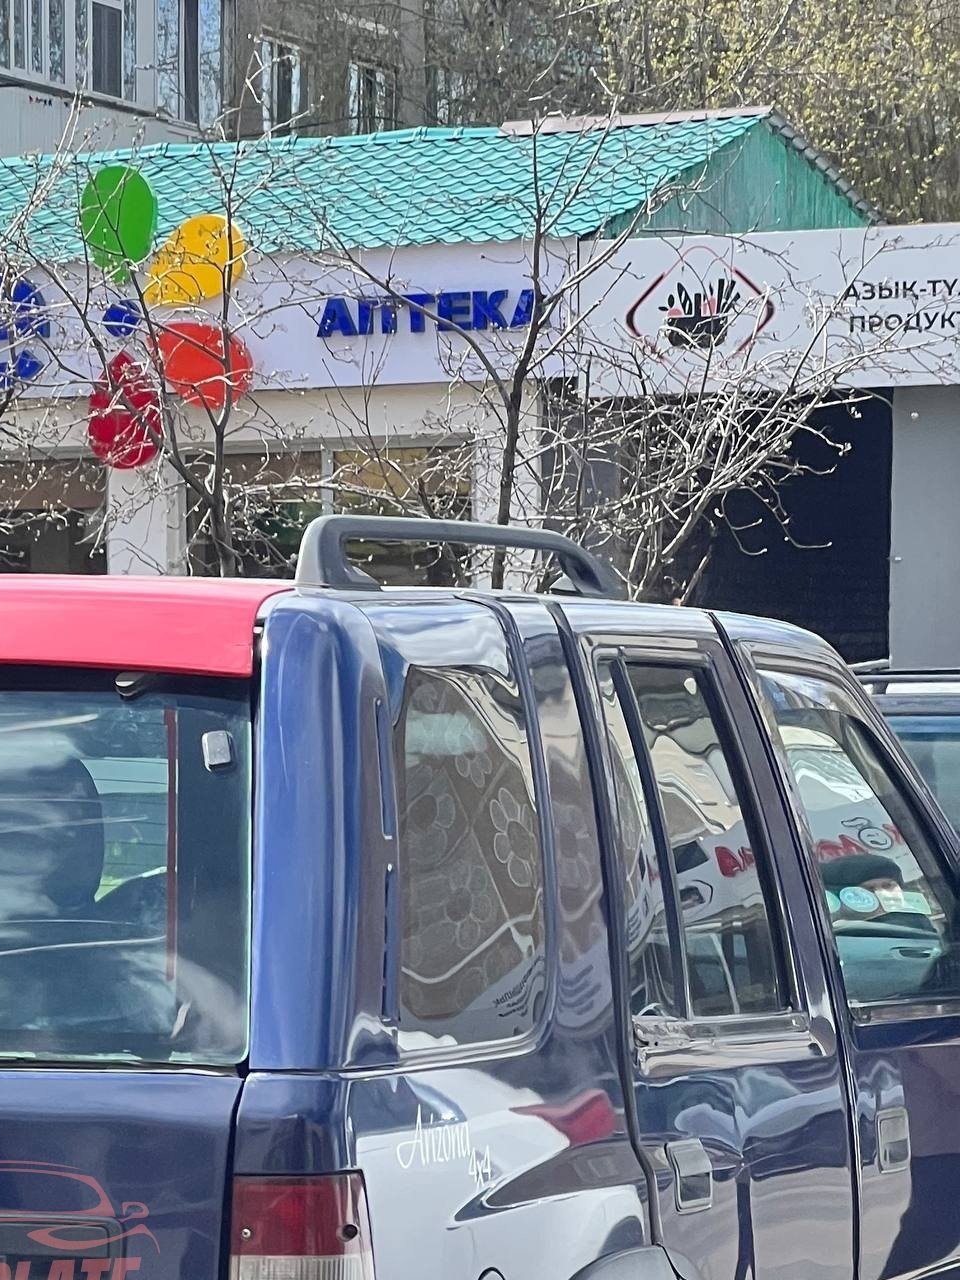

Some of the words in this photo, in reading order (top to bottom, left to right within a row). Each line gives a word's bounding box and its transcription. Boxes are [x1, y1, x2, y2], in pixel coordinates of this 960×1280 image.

[843, 279, 960, 300] АЗЫҚ-ТҮ
[316, 288, 552, 338] АПТЕКА
[849, 311, 960, 333] ПРОДУК
[396, 1103, 471, 1169] Arizona
